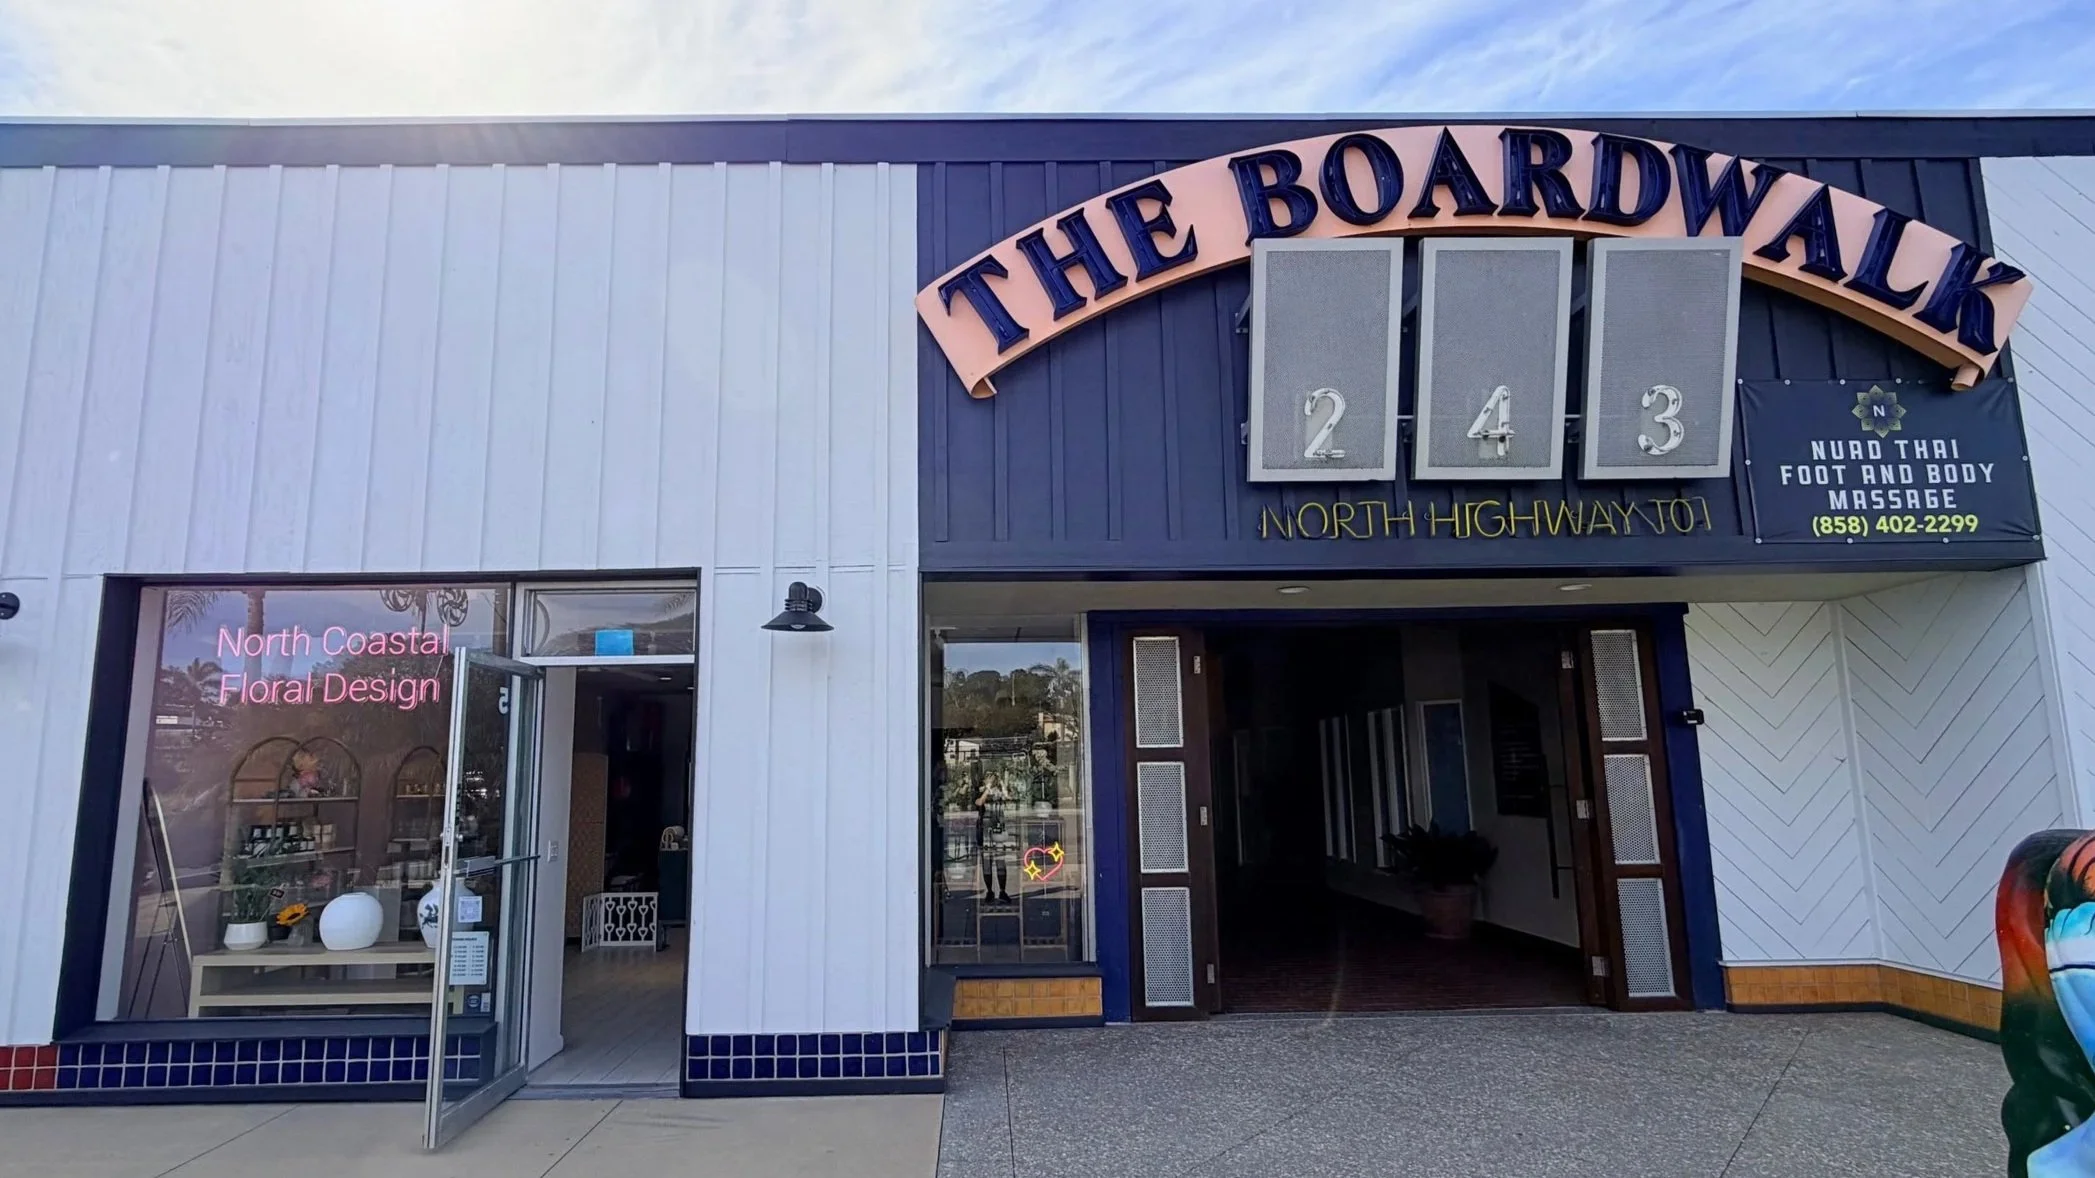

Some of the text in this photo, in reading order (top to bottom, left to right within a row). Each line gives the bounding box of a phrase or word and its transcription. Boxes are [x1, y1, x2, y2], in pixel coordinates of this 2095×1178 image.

[938, 126, 2026, 354] THE BOARDWALK
[1304, 384, 1685, 459] 2 4 3
[1873, 405, 1886, 417] N
[1811, 439, 1959, 460] NUAD THAI
[1780, 463, 1994, 485] FOOT AND BODY
[1828, 489, 1957, 510] MASSAGE
[1260, 500, 1415, 539] NORTH
[1428, 500, 1637, 538] HIGHWAY
[1812, 514, 1979, 537] (858) 402-2299
[217, 623, 449, 657] North Coastal
[219, 667, 440, 710] Floral Design
